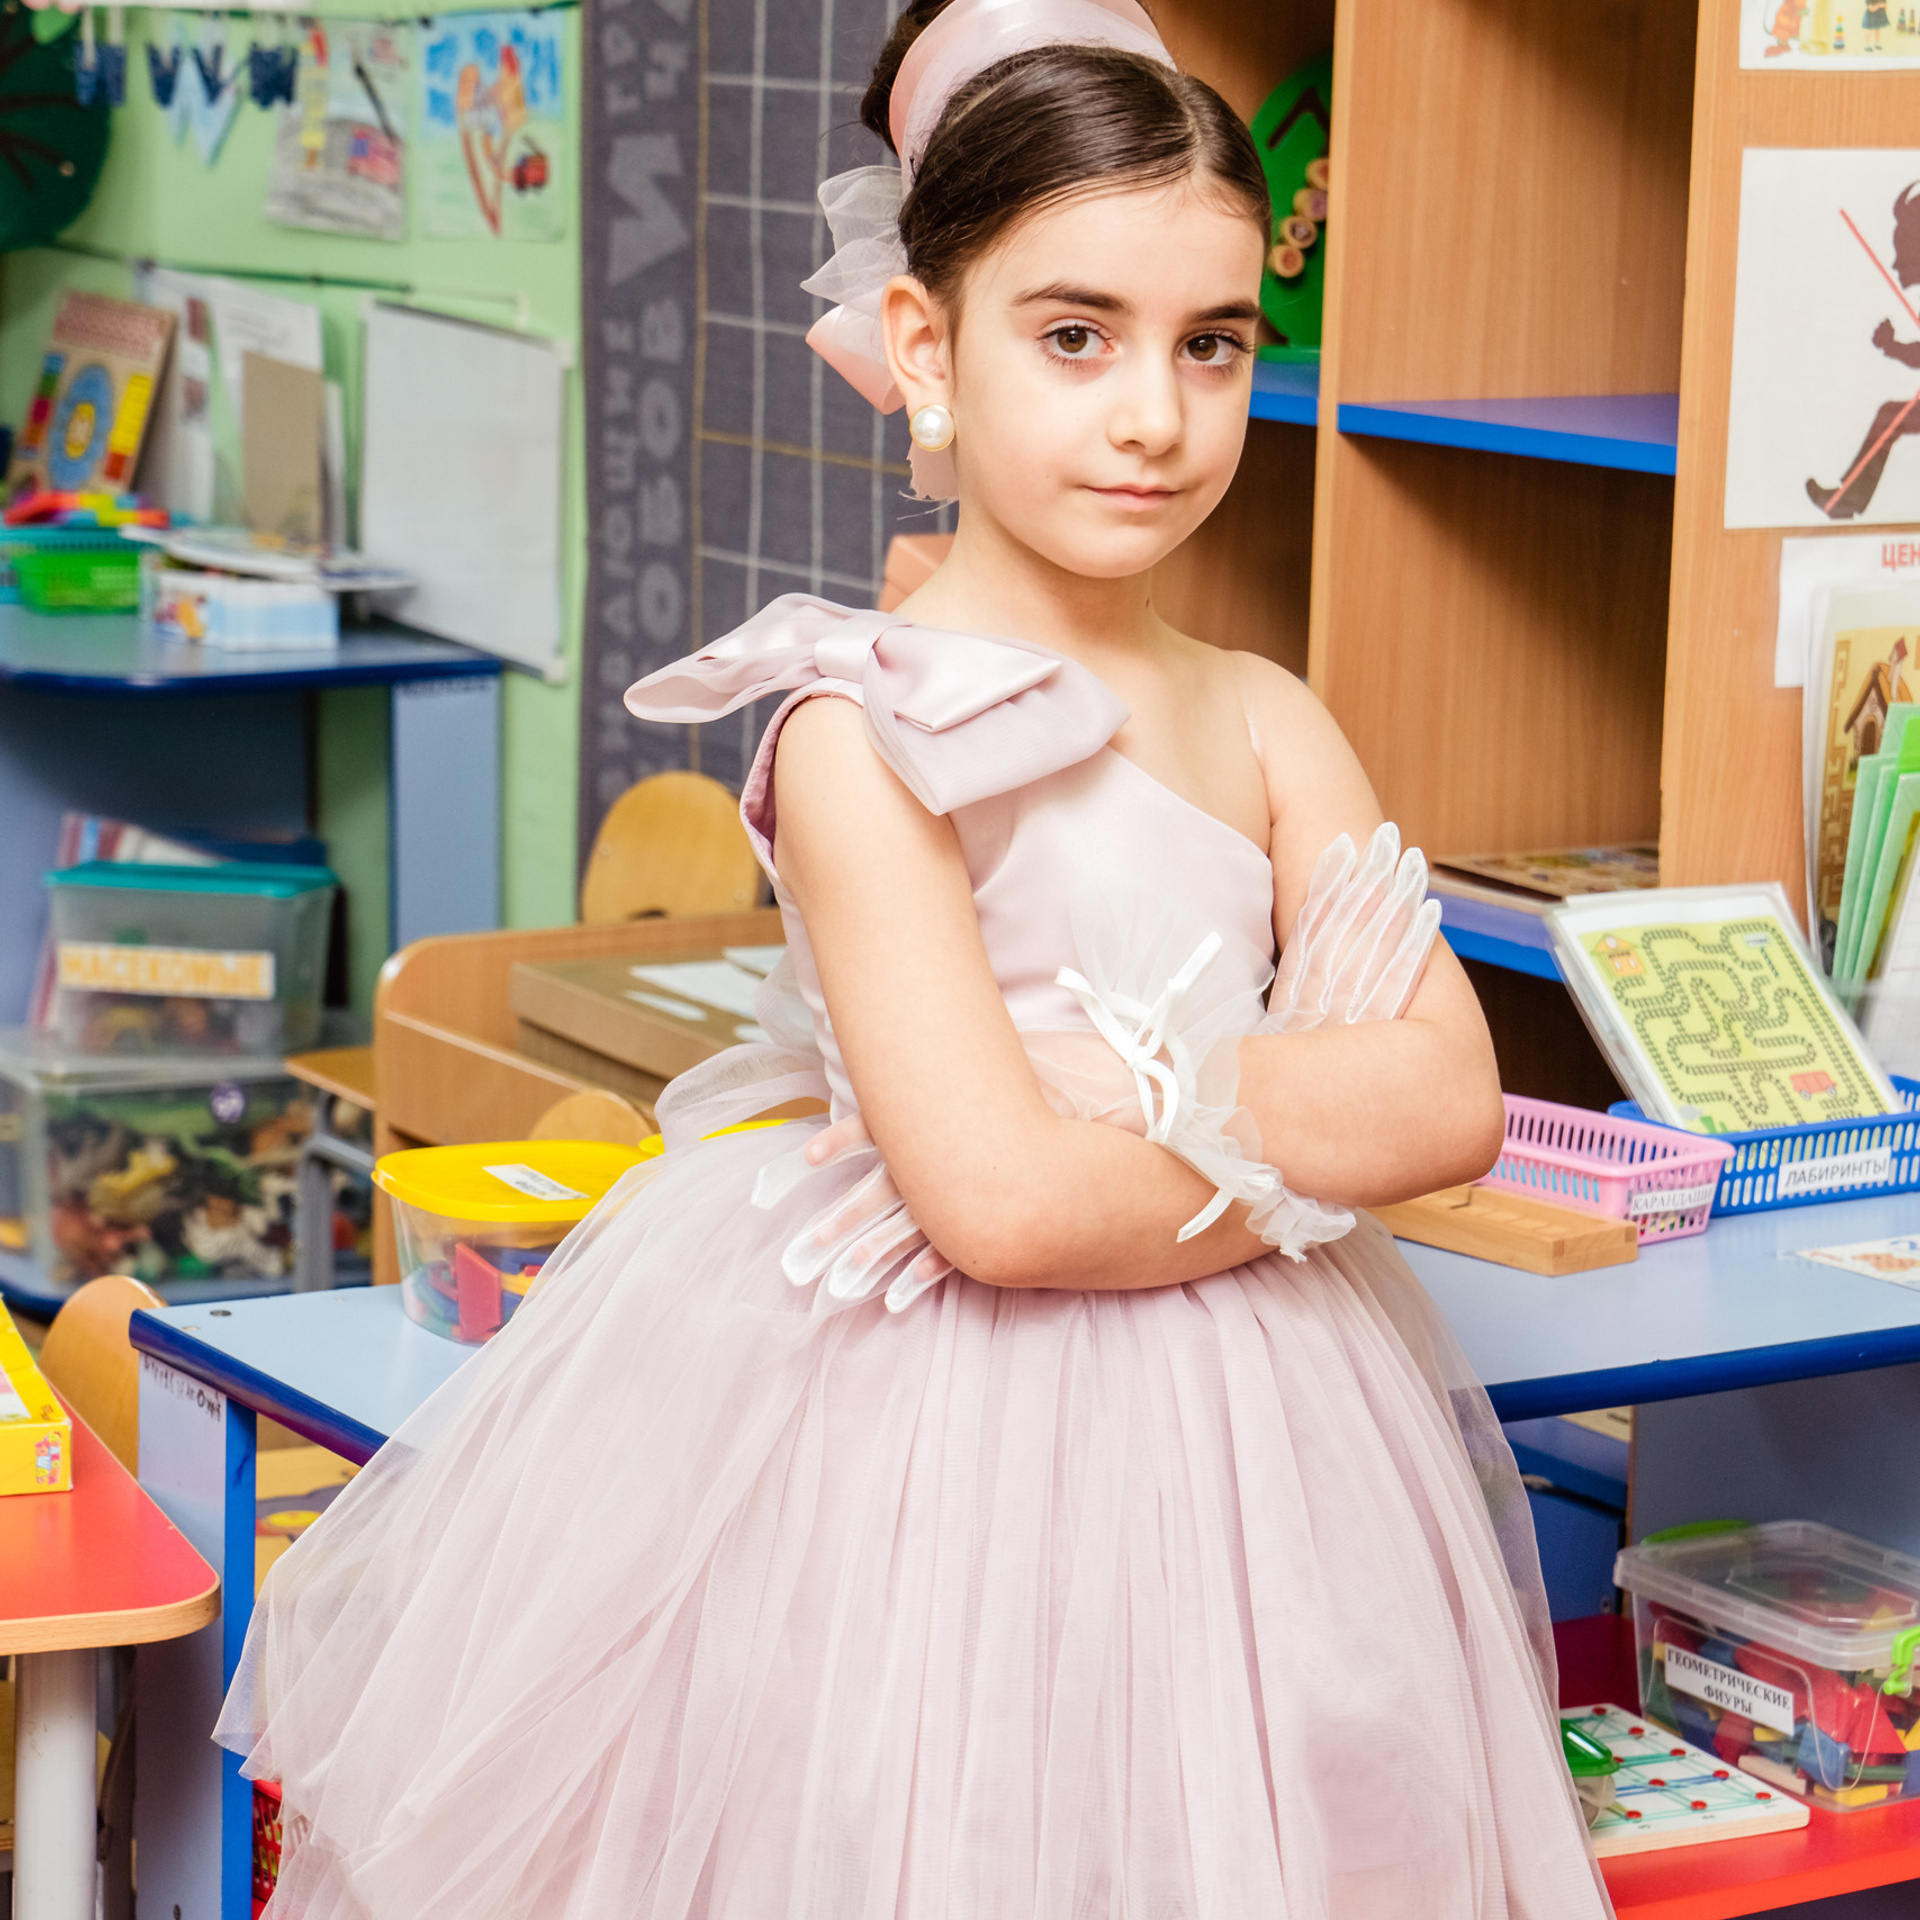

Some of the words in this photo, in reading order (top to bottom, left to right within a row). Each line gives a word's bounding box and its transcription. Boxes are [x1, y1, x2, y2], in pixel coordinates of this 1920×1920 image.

[1881, 543, 1920, 572] ЦЕН
[1784, 1158, 1887, 1188] ЛАБИРИНТЫ
[1667, 1648, 1791, 1711] ГЕОМЕТРИЧЕСКИЕ
[1704, 1684, 1753, 1715] ФИУРЫ
